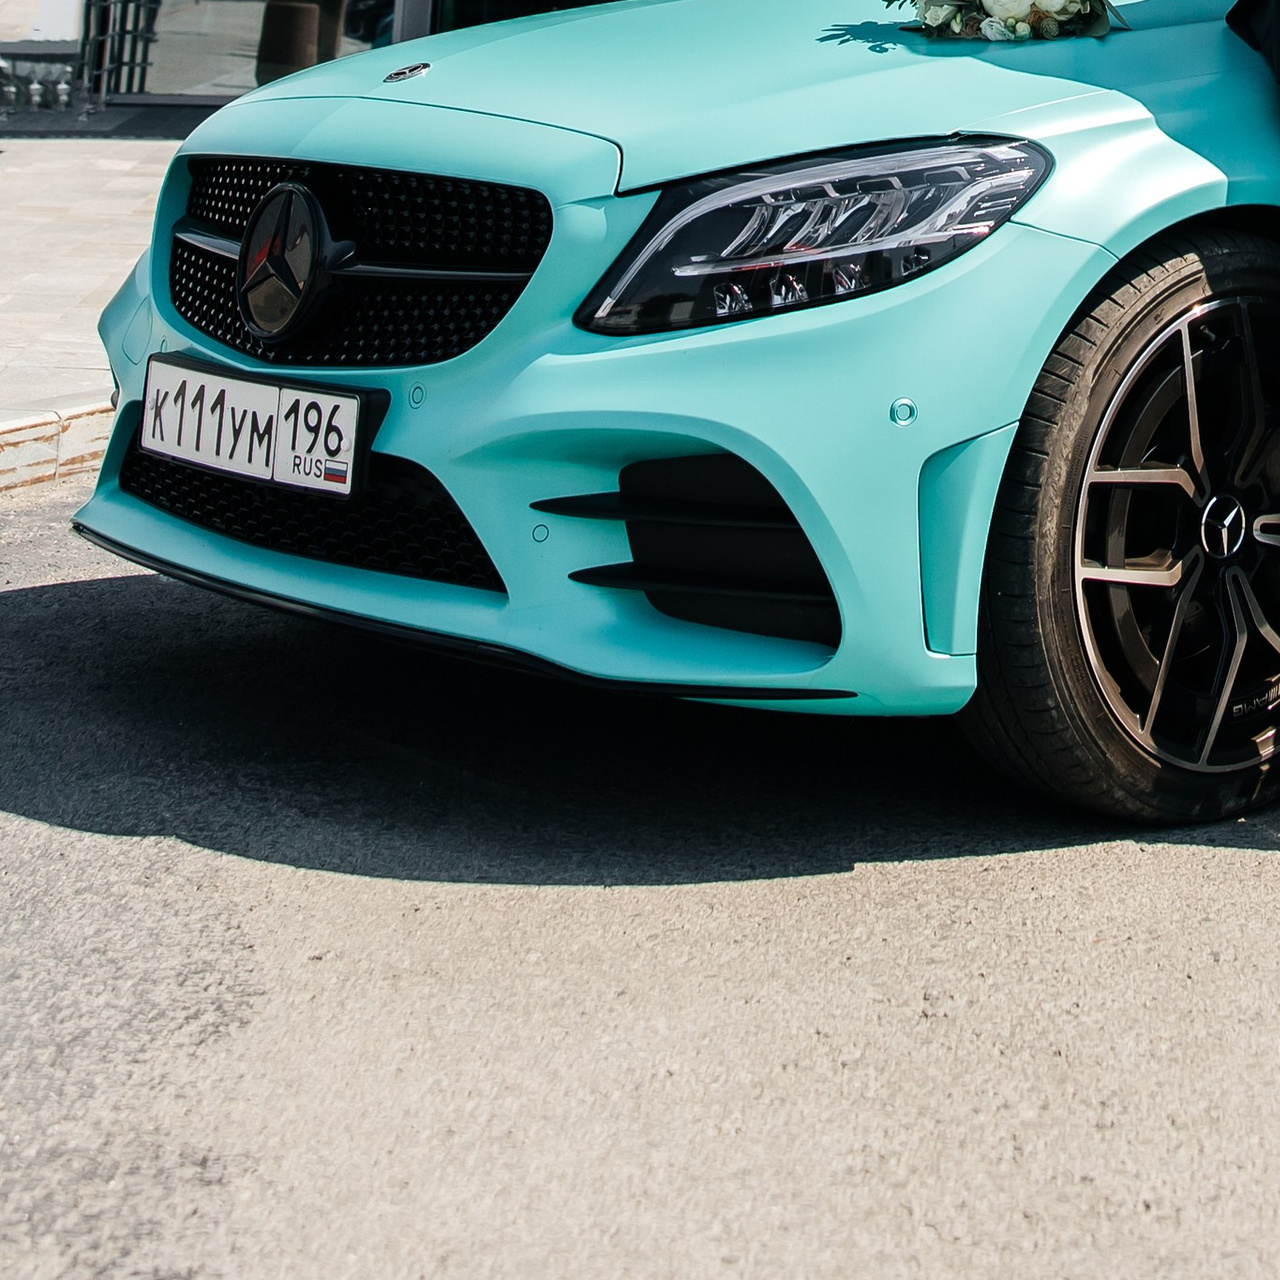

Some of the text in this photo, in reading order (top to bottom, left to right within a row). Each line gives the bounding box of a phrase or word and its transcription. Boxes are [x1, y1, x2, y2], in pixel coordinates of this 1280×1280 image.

[283, 397, 344, 458] 196
[292, 454, 323, 479] RUS
[1232, 692, 1268, 718] AMG
